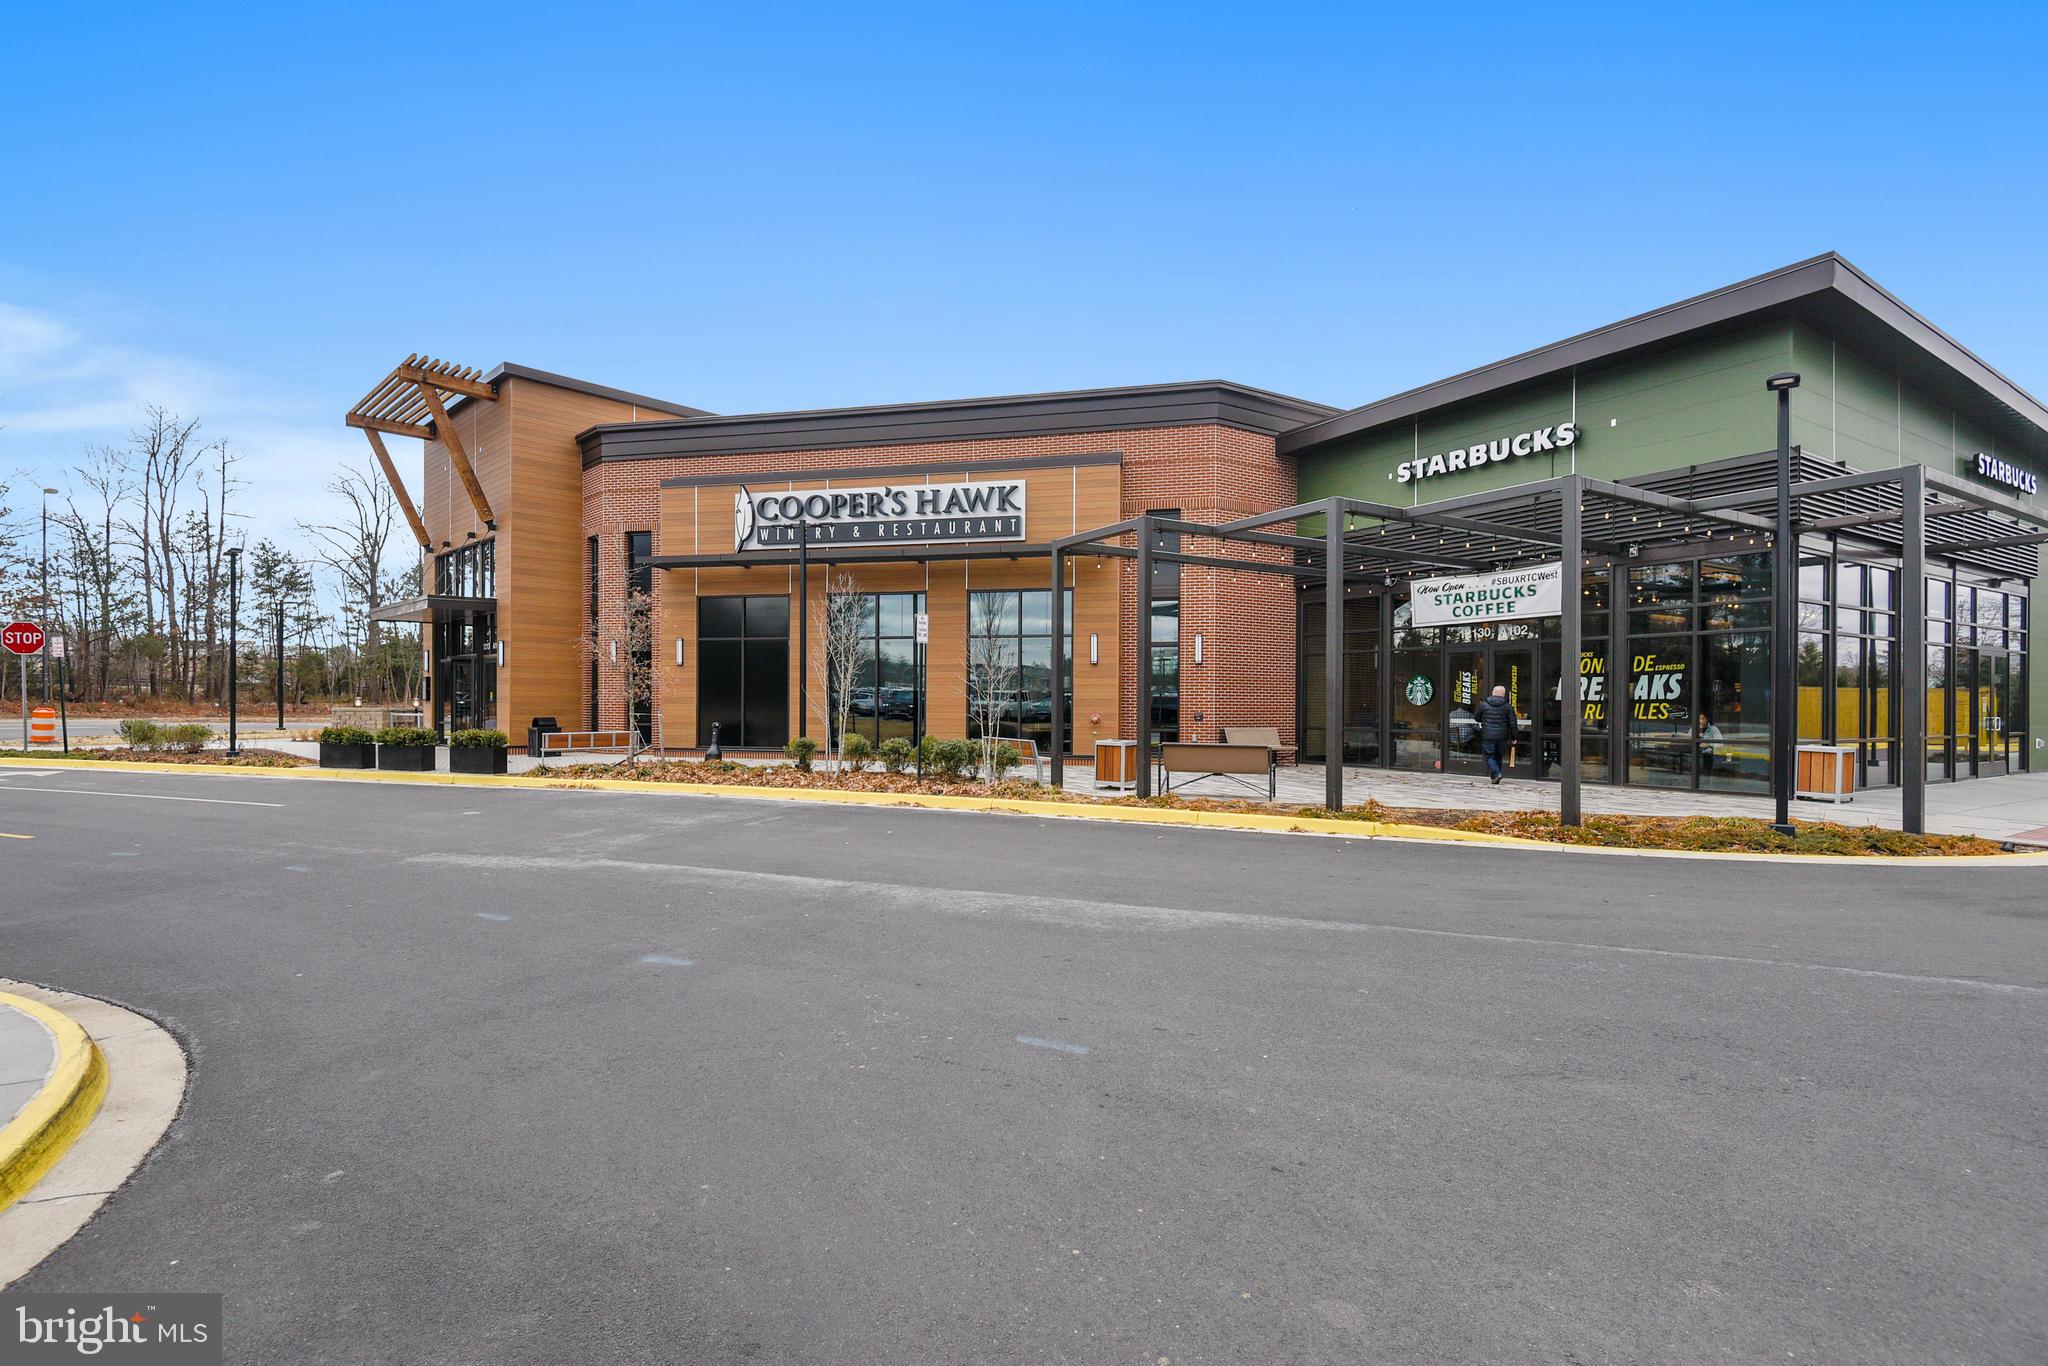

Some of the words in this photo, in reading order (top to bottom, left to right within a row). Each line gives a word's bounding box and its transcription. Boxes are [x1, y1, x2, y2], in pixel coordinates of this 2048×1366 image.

[1397, 422, 1580, 483] STARBUCKS
[1978, 452, 2037, 495] STARBUCKS
[756, 486, 908, 520] COOPER'S
[914, 485, 1022, 515] HAWK
[853, 526, 860, 538] &
[878, 518, 1017, 537] RESTAURANT
[1417, 584, 1440, 595] Now
[1442, 582, 1465, 593] Open
[1434, 584, 1537, 606] STARBUCKS
[1452, 601, 1516, 618] COFFEE
[5, 632, 42, 645] STOP
[1655, 663, 1685, 671] ESPRESSO
[1462, 671, 1471, 705] BREAKS
